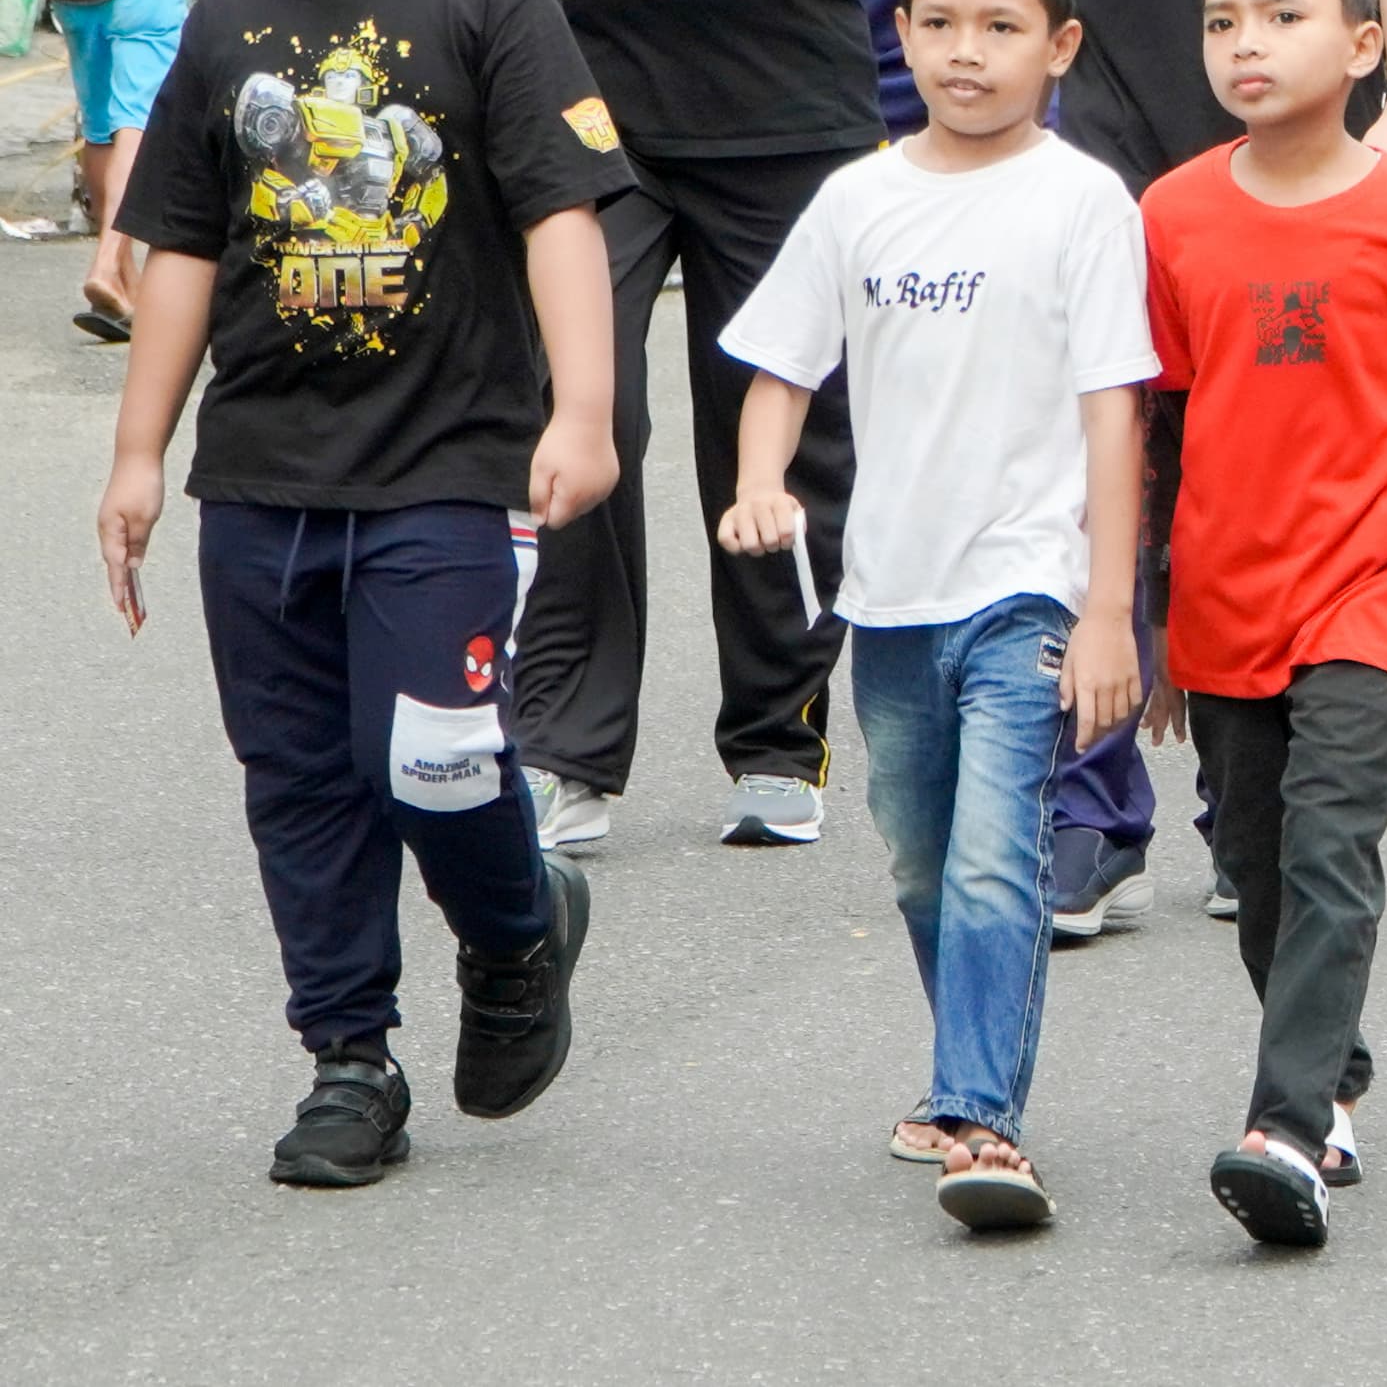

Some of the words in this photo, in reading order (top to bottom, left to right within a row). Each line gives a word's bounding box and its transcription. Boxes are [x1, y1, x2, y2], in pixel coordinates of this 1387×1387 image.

[279, 255, 409, 308] ONE
[863, 277, 891, 307] M.
[896, 270, 986, 313] Rafif
[401, 764, 482, 784] SPIDER-MAN
[414, 758, 470, 773] AMAZING
